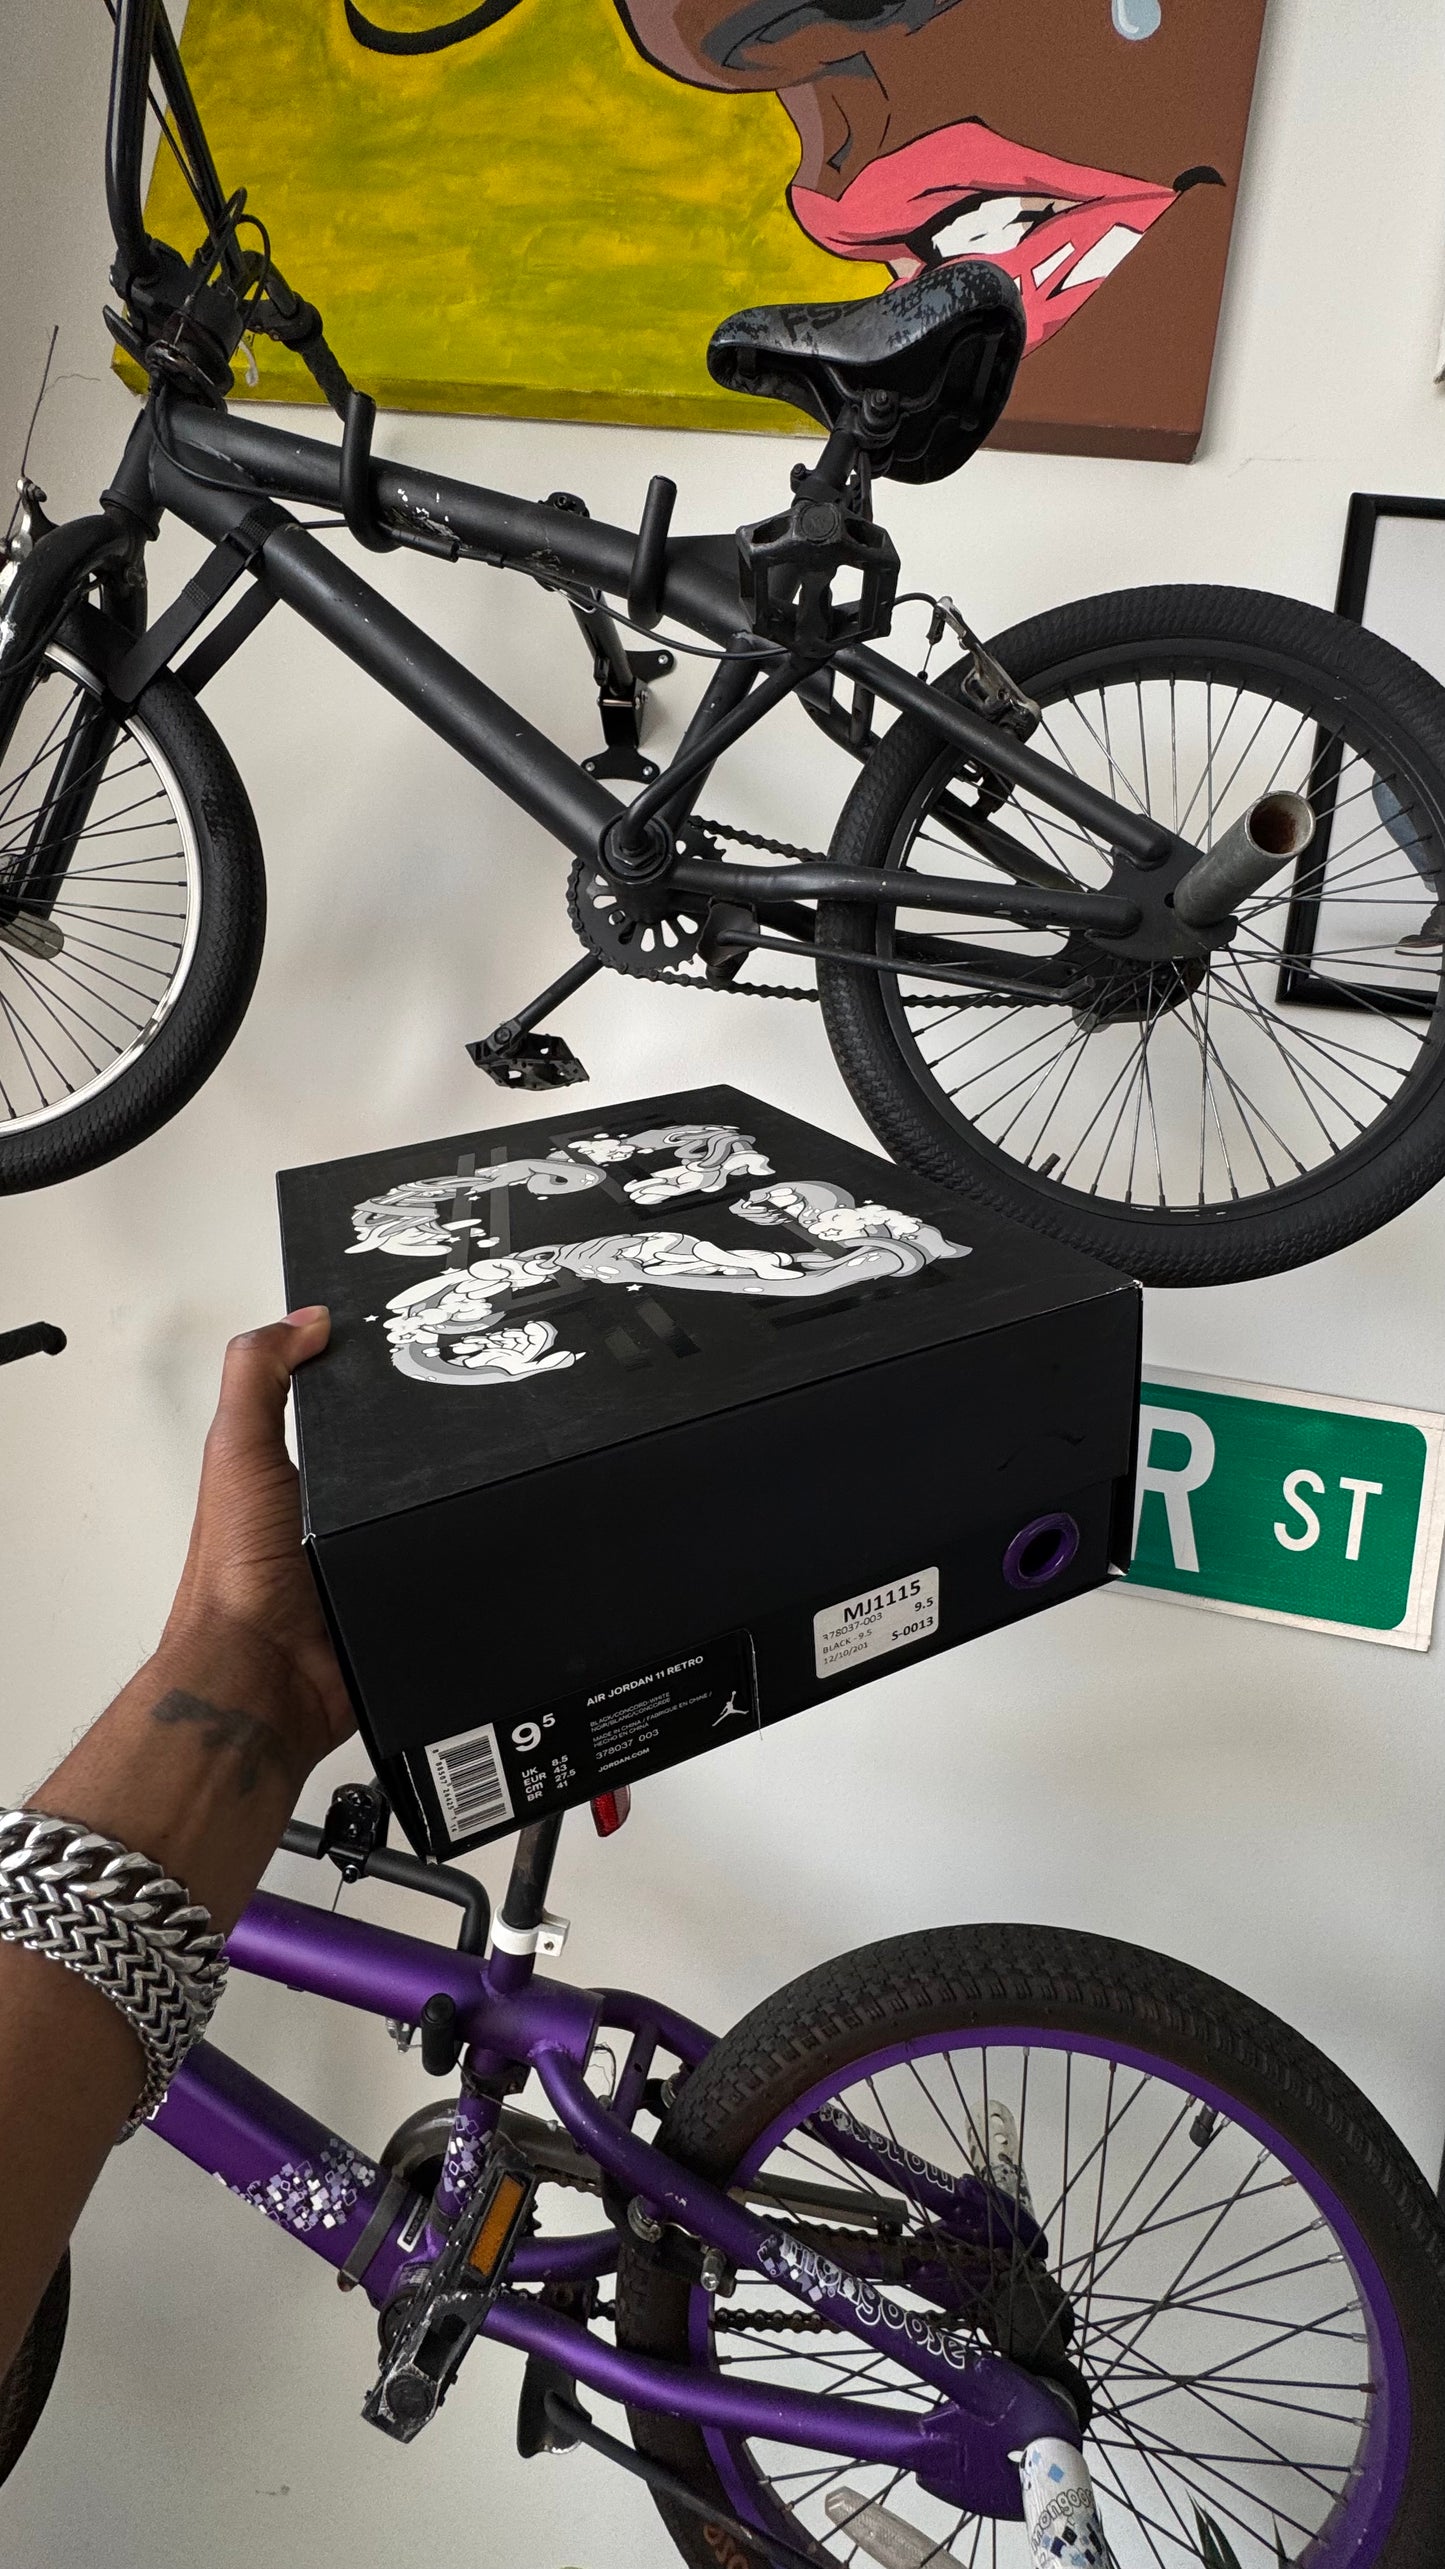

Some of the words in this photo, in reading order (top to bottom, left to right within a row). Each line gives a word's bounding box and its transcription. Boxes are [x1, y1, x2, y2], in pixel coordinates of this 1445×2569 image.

[1130, 1403, 1216, 1573] R
[1273, 1468, 1384, 1561] ST
[843, 1579, 921, 1623] MJ1115
[914, 1596, 934, 1612] 9.5
[822, 1638, 851, 1654] BLACK
[858, 1628, 873, 1640] 9.5
[891, 1616, 934, 1641] S-0013
[586, 1693, 606, 1707] AIR
[608, 1674, 654, 1699] JORDAN
[655, 1670, 666, 1680] 11
[667, 1656, 704, 1676] RETRO
[592, 1731, 612, 1743] MADE
[621, 1719, 642, 1732] CHINA
[593, 1734, 618, 1748] HECHO
[629, 1722, 649, 1735] CHINA
[595, 1739, 634, 1760] 378037
[638, 1728, 660, 1742] 003
[521, 1766, 538, 1778] UK
[551, 1754, 569, 1767] 8.5
[598, 1747, 650, 1773] JORDAN.COM
[523, 1771, 547, 1787] EUR
[553, 1764, 568, 1774] 43
[525, 1781, 544, 1794] cm
[554, 1768, 577, 1783] 27.5
[526, 1790, 543, 1802] BR
[556, 1780, 568, 1789] 41
